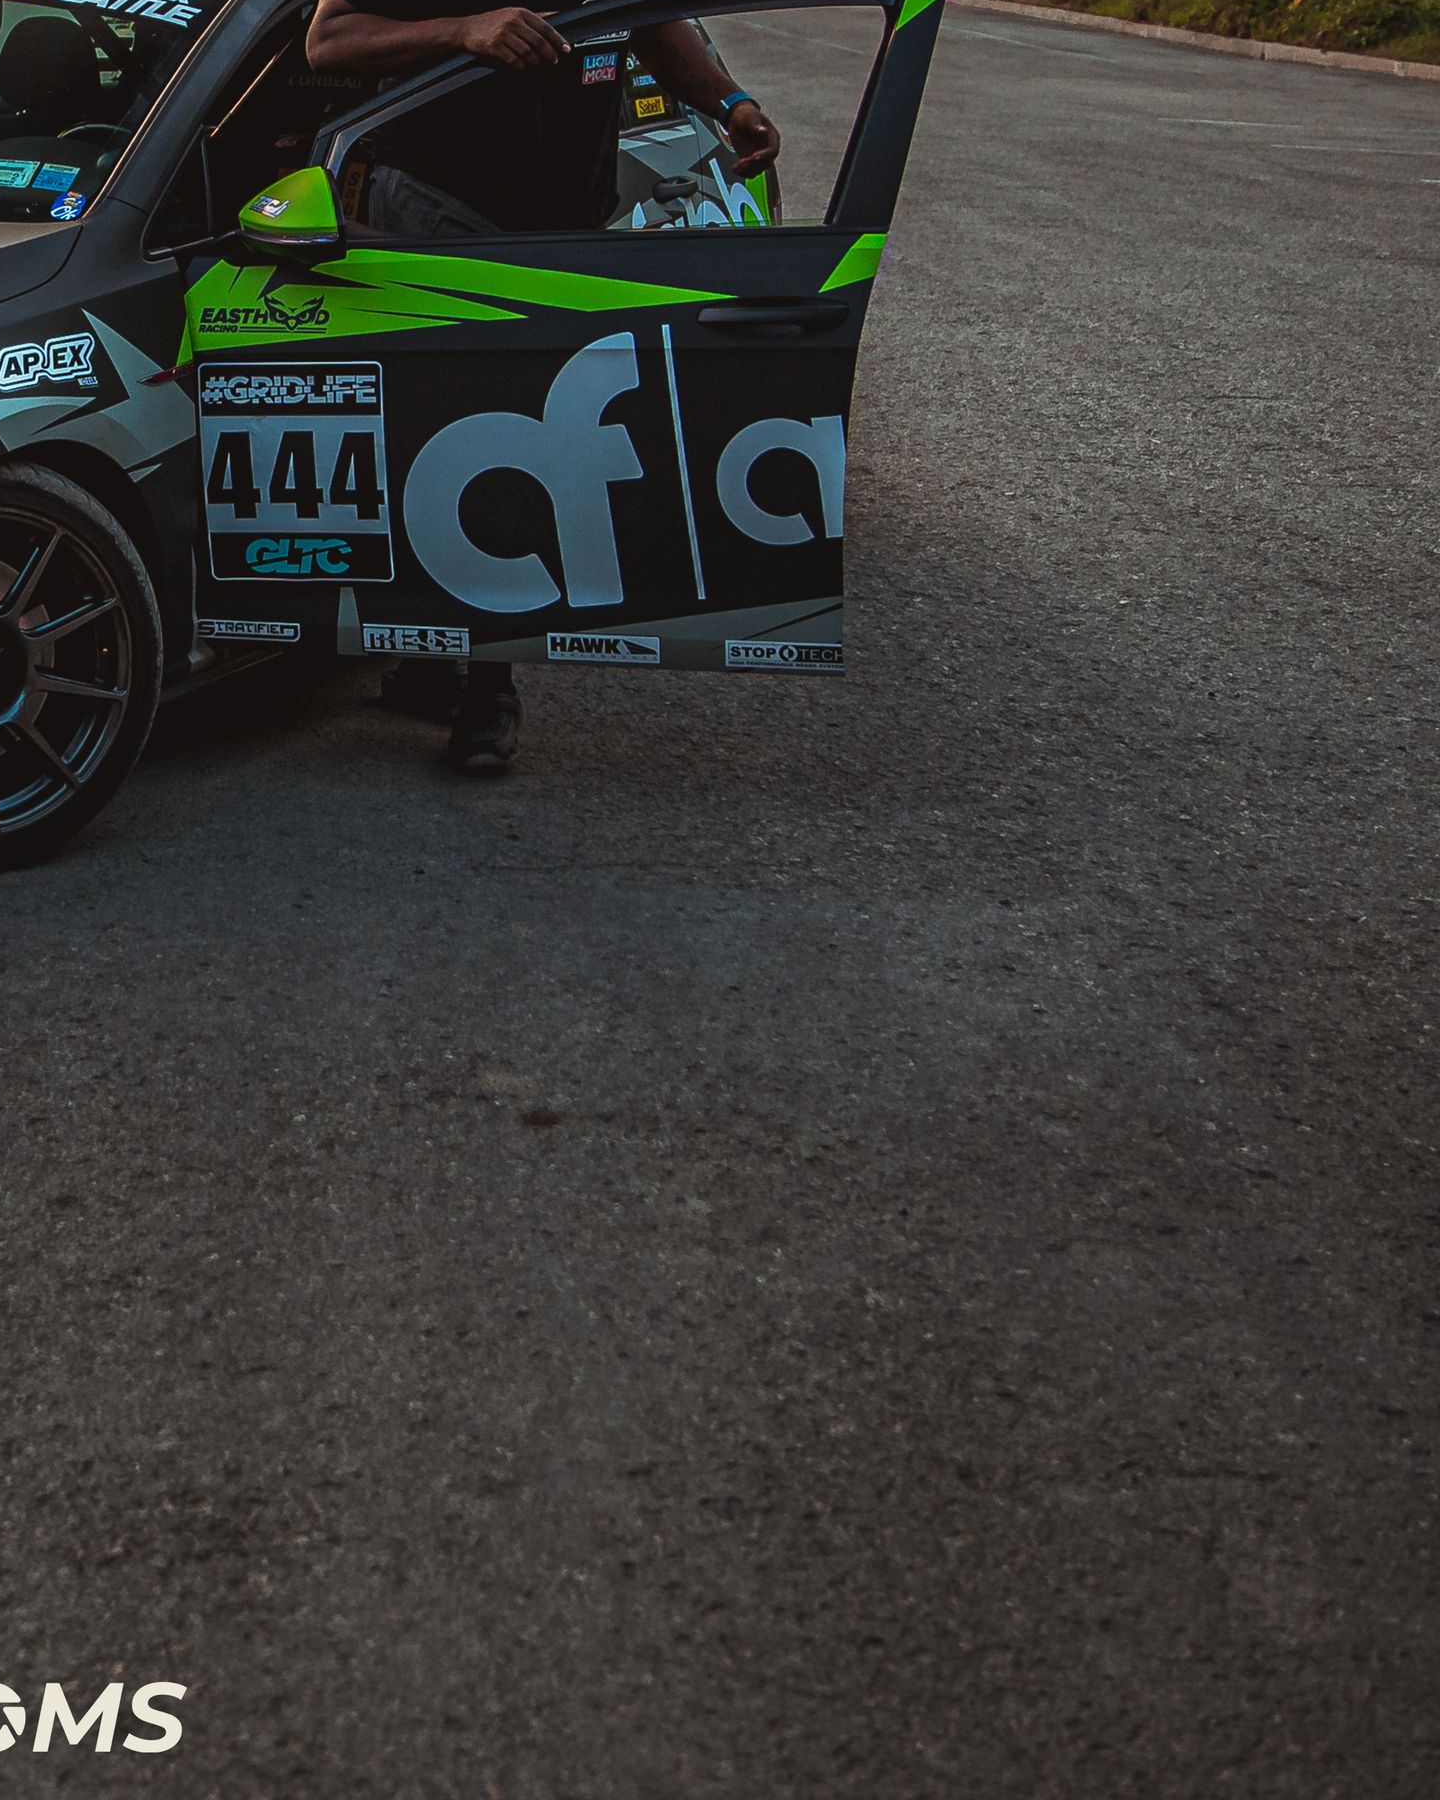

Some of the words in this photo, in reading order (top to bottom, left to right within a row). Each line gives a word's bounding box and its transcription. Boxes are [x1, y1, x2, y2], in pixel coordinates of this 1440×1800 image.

[586, 54, 616, 69] LIQUI
[585, 67, 615, 82] MOLY
[199, 324, 238, 333] RACING
[0, 341, 90, 383] APEX
[202, 375, 377, 405] #GRIDLIFE
[206, 431, 386, 521] 444
[197, 619, 301, 642] STRATIFIED
[549, 636, 622, 655] HAWK
